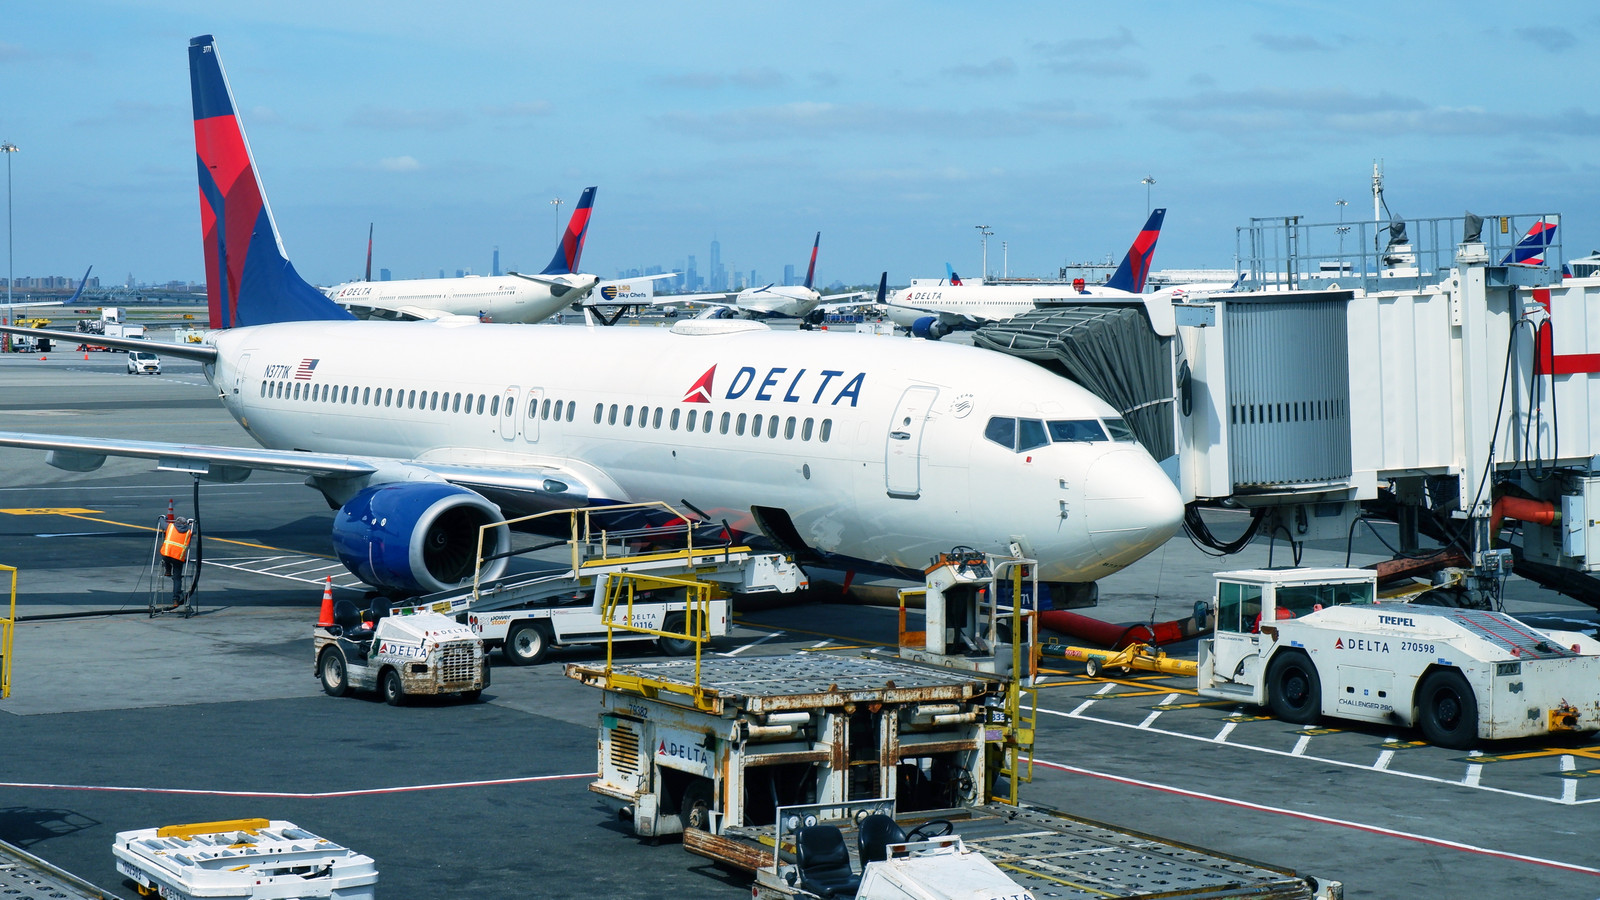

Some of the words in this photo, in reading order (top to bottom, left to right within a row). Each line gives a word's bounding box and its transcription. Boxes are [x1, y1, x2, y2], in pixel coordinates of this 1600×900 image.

[346, 288, 372, 296] DELTA
[263, 364, 292, 379] N3771K
[725, 366, 866, 407] DELTA
[1378, 615, 1416, 627] TREPEL
[390, 644, 427, 658] DELTA
[1348, 639, 1390, 653] DELTA
[1402, 642, 1435, 654] 270598
[1339, 699, 1379, 709] CHALLENGER
[670, 742, 708, 764] DELTA
